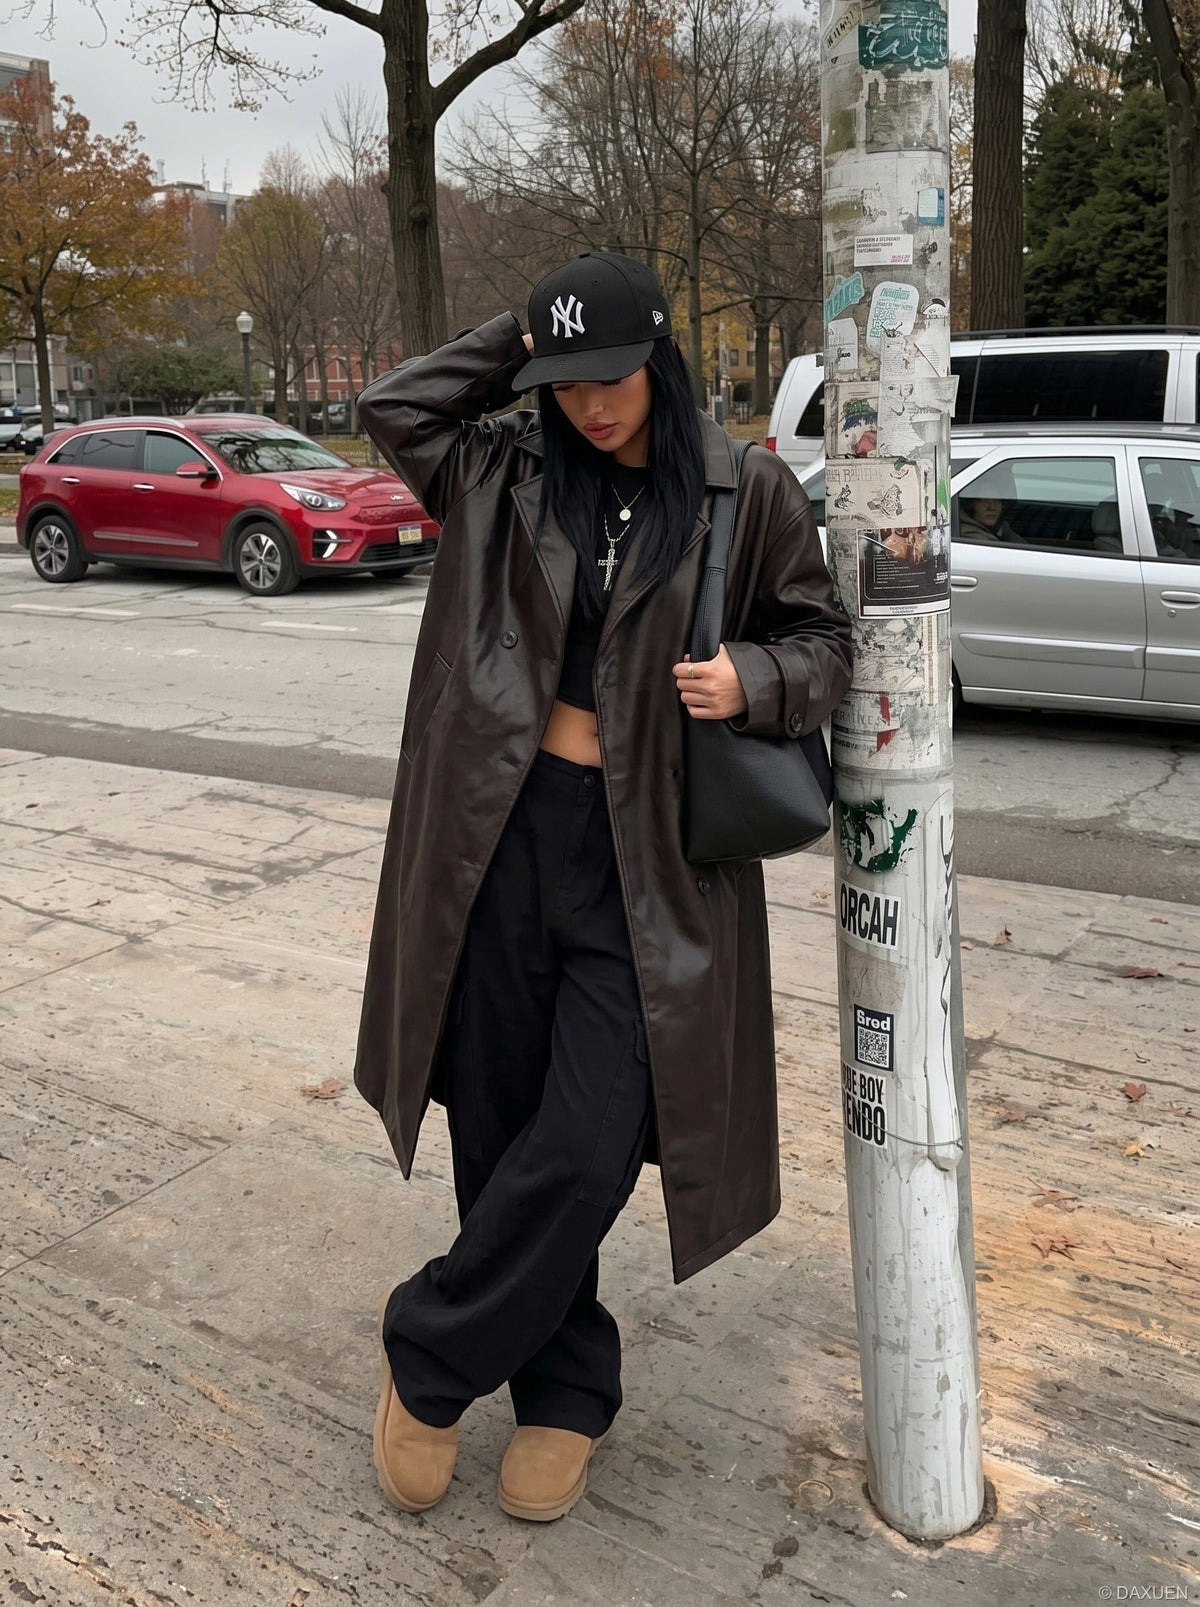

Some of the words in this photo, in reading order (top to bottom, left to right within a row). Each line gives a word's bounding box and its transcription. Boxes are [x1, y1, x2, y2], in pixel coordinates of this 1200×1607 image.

[550, 294, 586, 338] NY
[840, 883, 899, 946] ORCAH
[860, 1073, 884, 1105] BOY
